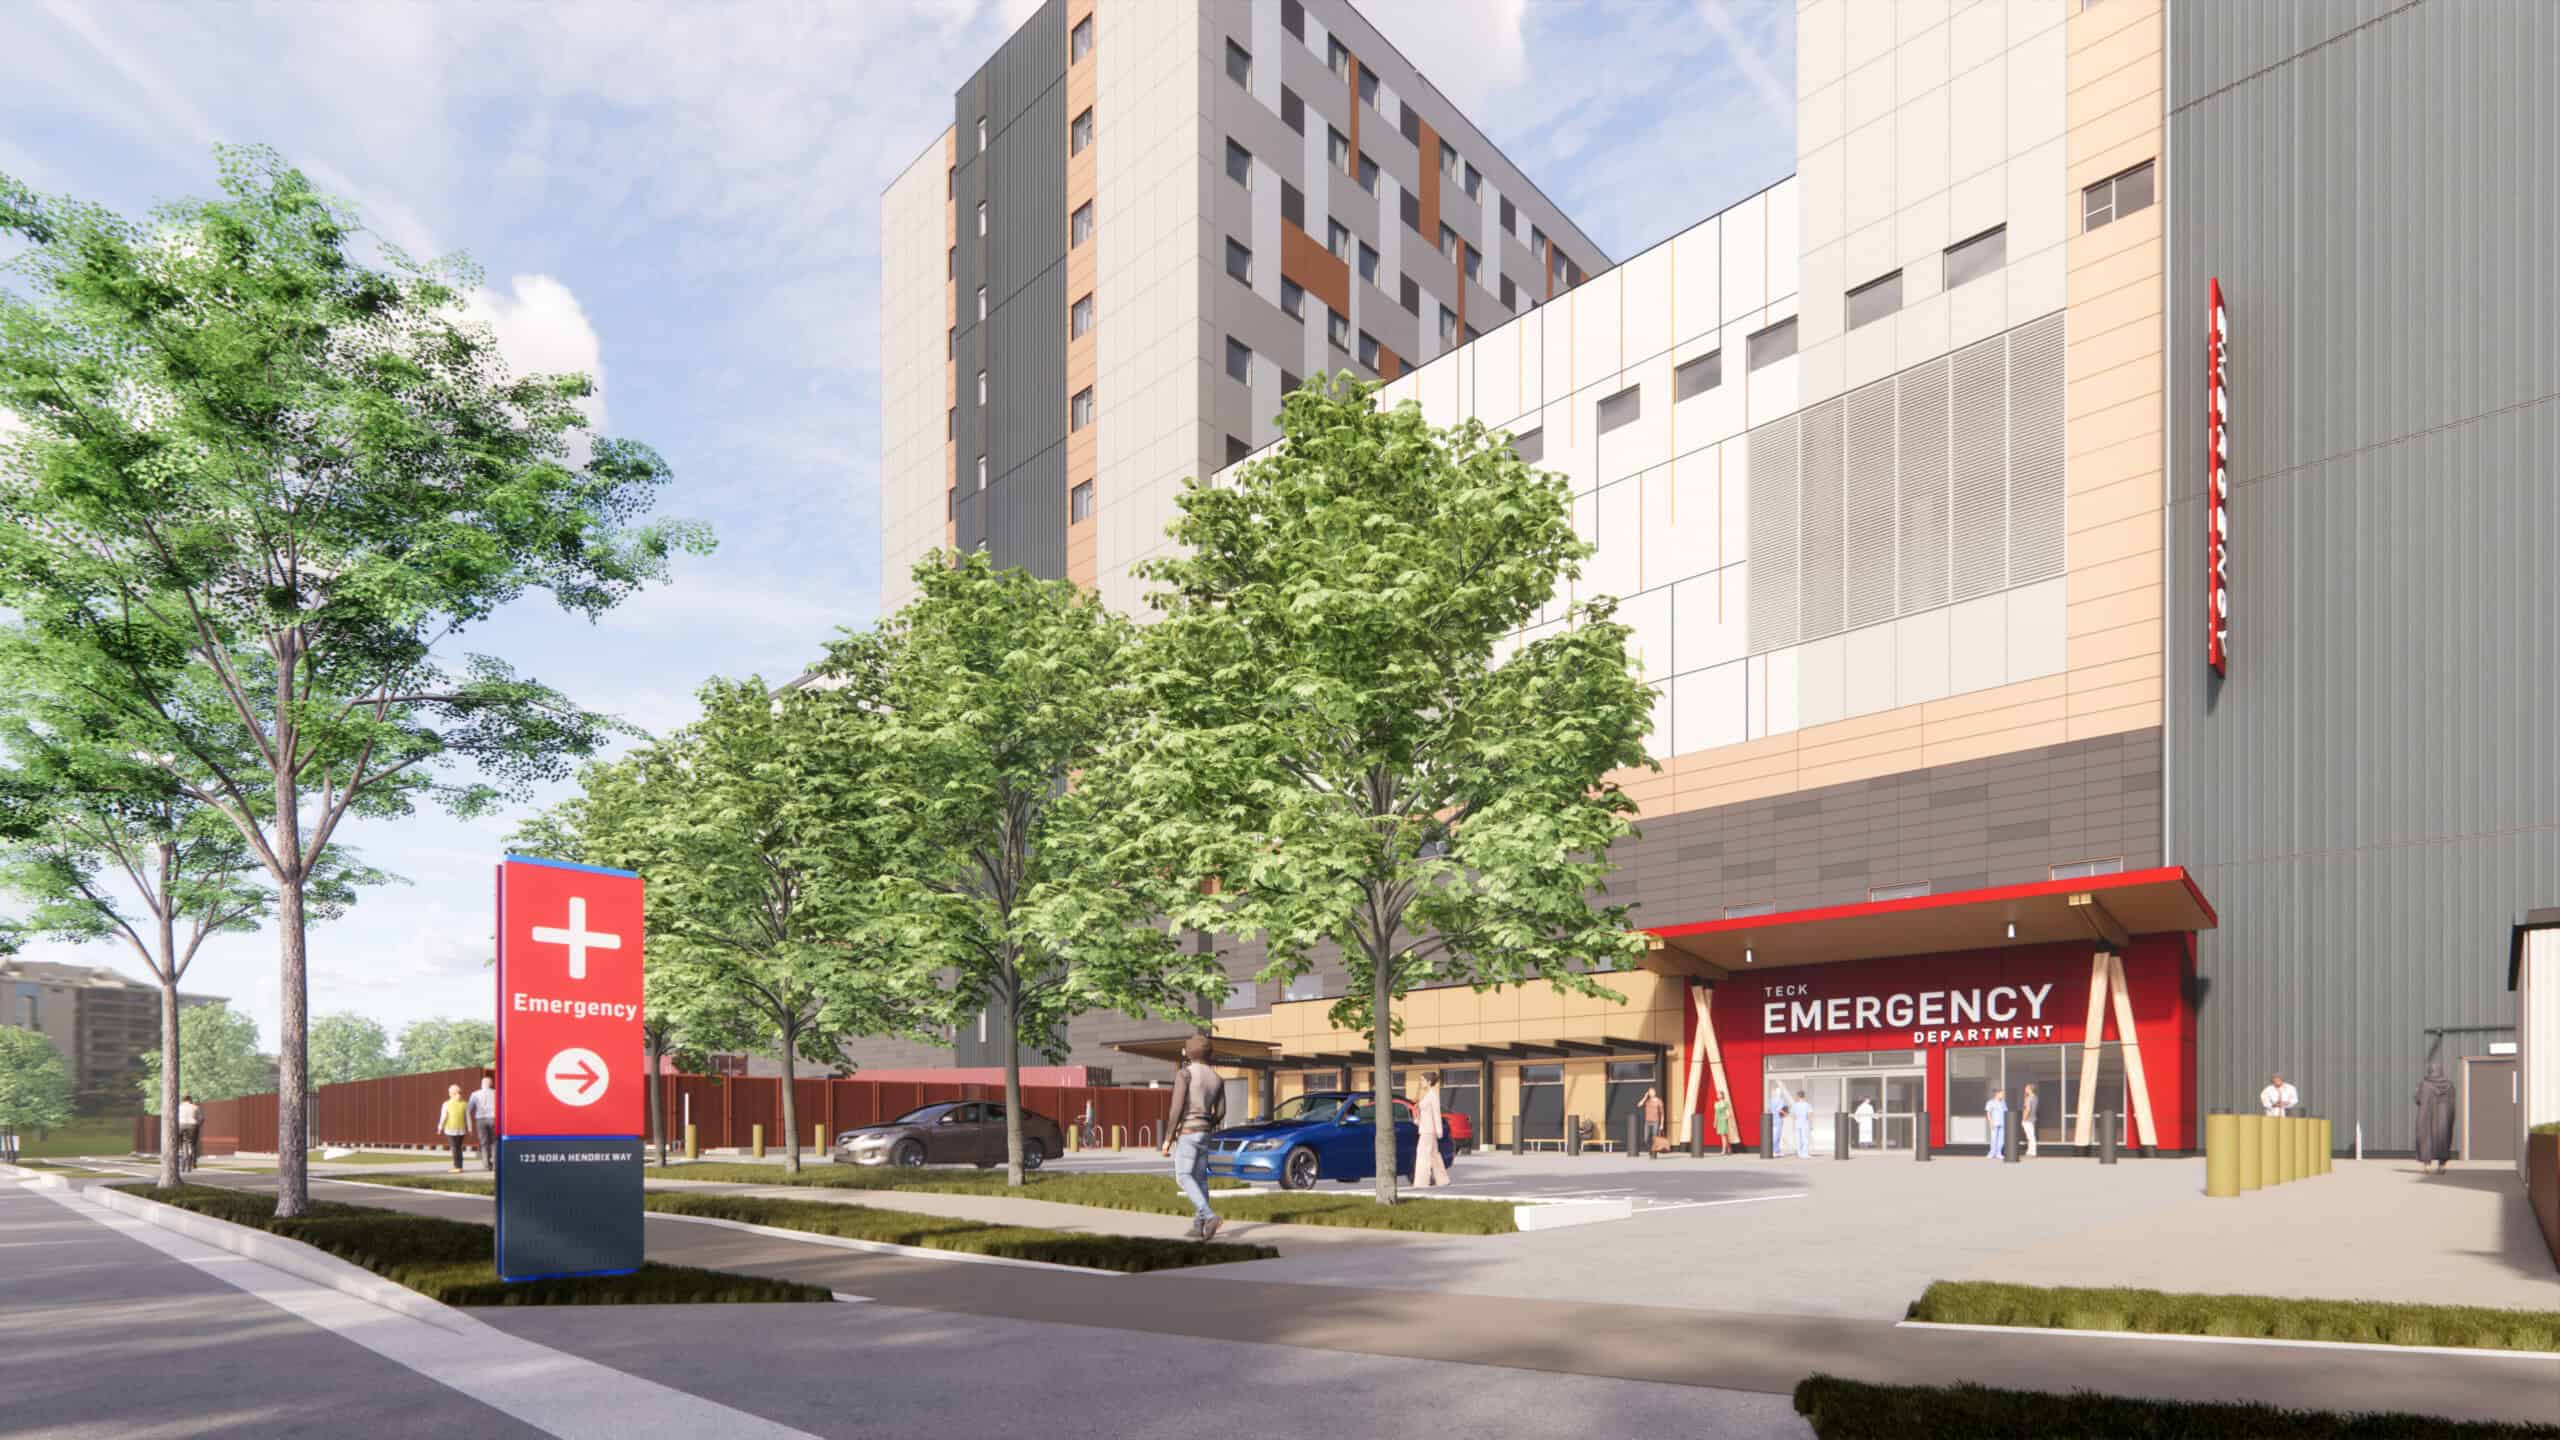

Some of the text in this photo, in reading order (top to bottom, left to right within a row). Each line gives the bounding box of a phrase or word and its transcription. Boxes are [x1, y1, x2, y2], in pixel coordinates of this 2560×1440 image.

[1765, 983, 1808, 997] TECK
[513, 992, 637, 1020] Emergency
[1763, 984, 2053, 1034] EMERGENCY
[1913, 1024, 2055, 1043] DEPARTMENT
[538, 1153, 566, 1163] NORA
[568, 1153, 610, 1162] HENDRIX
[612, 1153, 632, 1161] WAY
